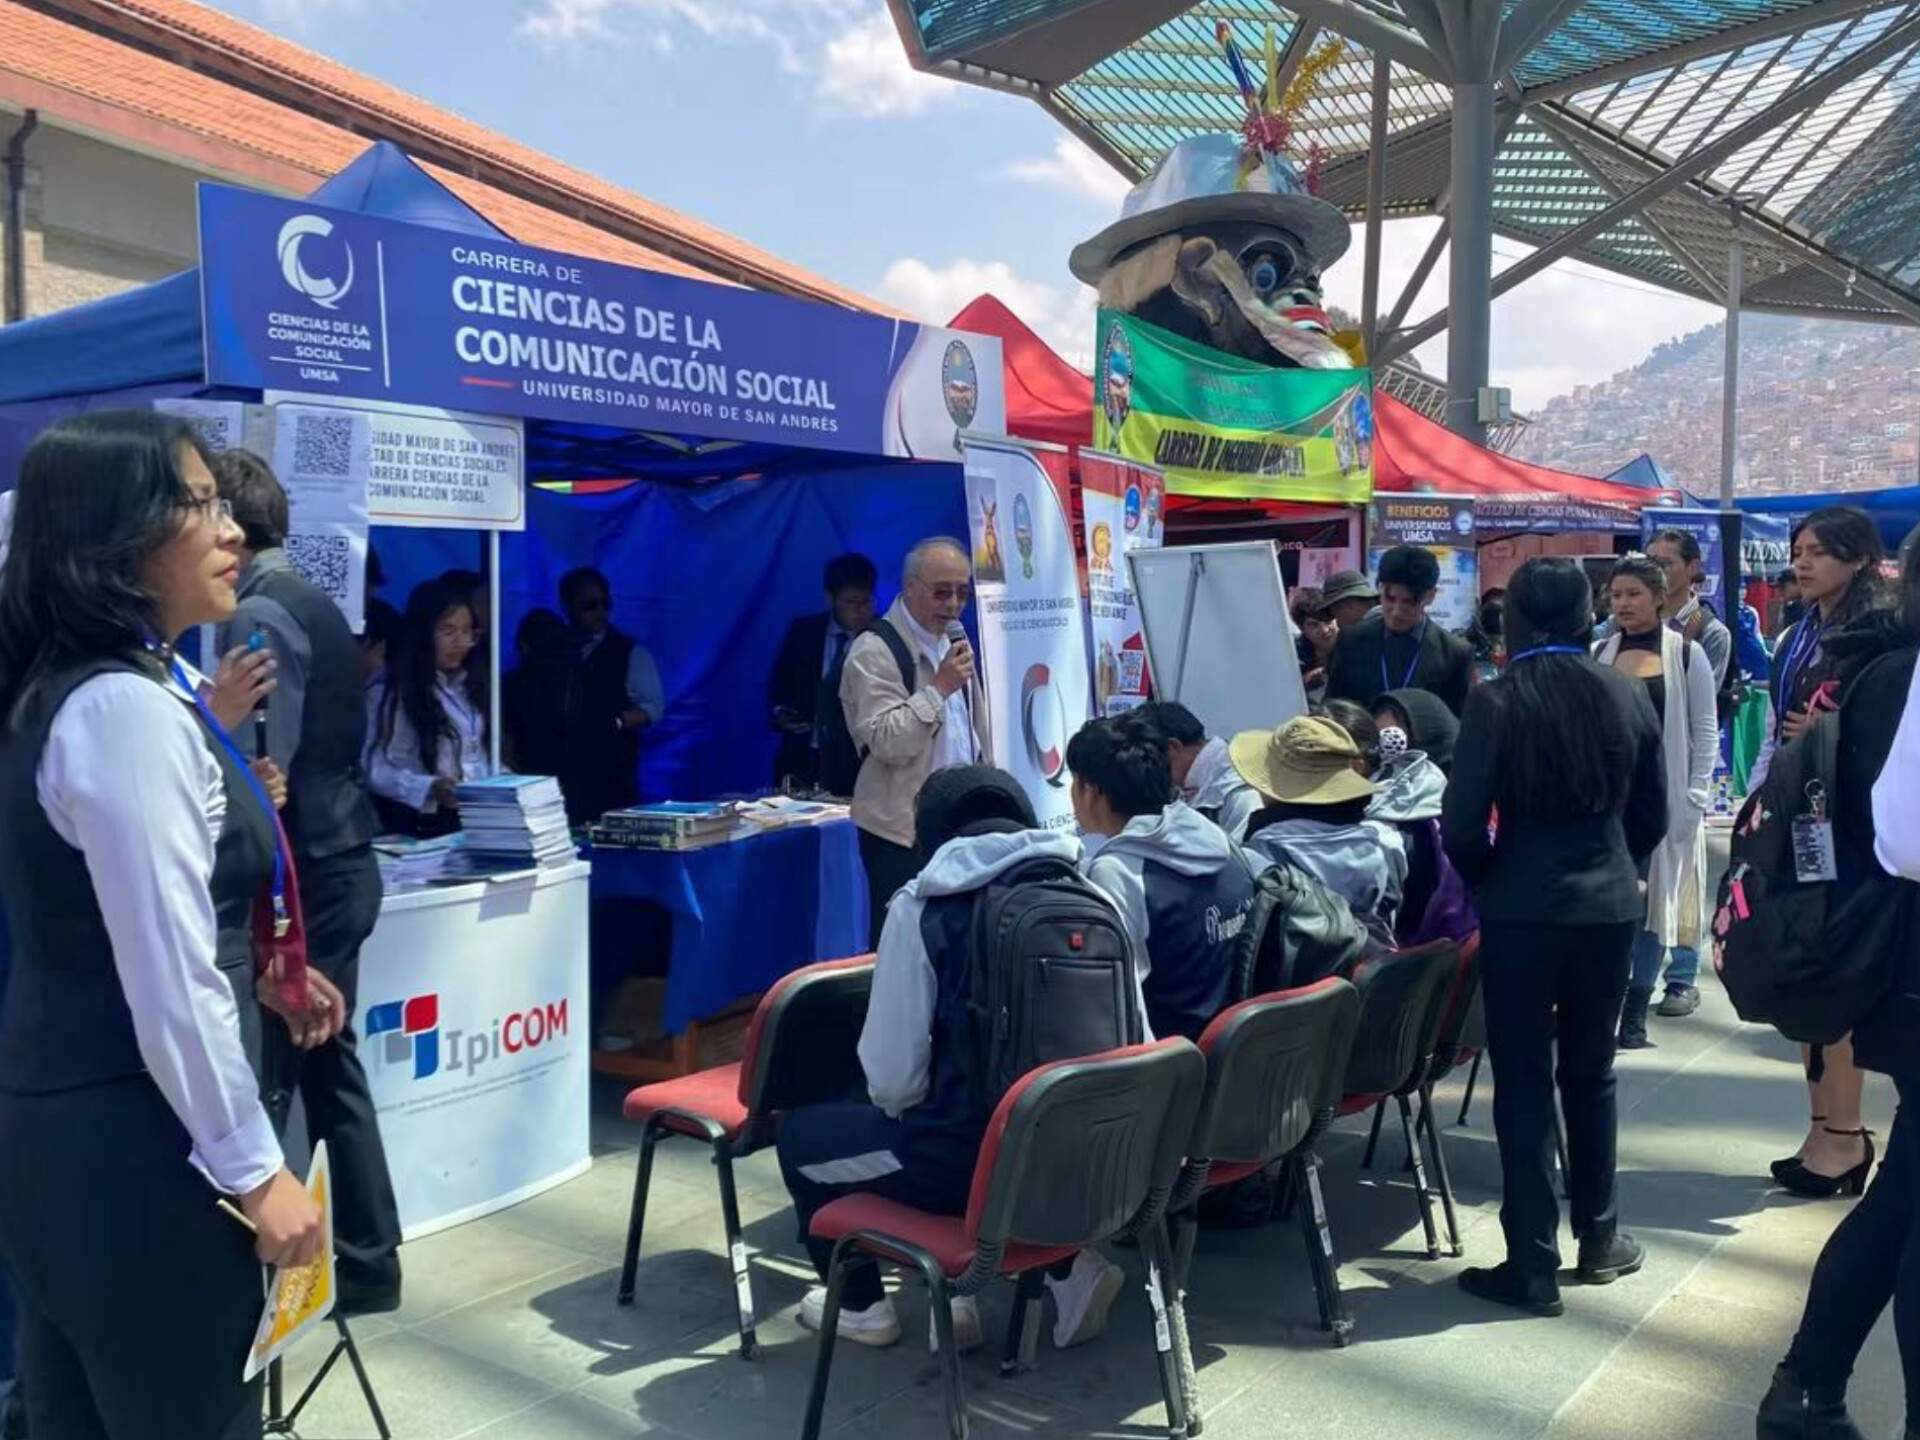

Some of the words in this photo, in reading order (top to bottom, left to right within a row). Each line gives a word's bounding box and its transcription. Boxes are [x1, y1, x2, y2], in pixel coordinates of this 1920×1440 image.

[451, 247, 549, 278] CARRERA
[556, 265, 583, 284] DE
[452, 275, 626, 334] CIENCIAS
[634, 306, 677, 343] DE
[685, 315, 722, 351] LA
[268, 312, 330, 331] CIENCIAS
[332, 321, 350, 334] DE
[352, 325, 369, 337] LA
[267, 327, 371, 351] COMUNICACIÓN
[295, 345, 343, 362] SOCIAL
[300, 367, 339, 382] UMSA
[455, 326, 728, 396] COMUNICACIÓN
[736, 369, 836, 410] SOCIAL
[522, 379, 649, 409] UNIVERSIDAD
[656, 396, 713, 418] MAYOR
[719, 405, 740, 421] DE
[745, 409, 775, 425] SAN
[780, 412, 839, 433] ANDRÉS
[406, 434, 440, 449] MAYOR
[443, 438, 456, 452] DE
[459, 439, 478, 454] SAN
[397, 449, 411, 465] DE
[414, 451, 460, 469] CIENCIAS
[463, 457, 507, 473] SOCIALES
[413, 468, 459, 486] CIENCIAS
[462, 473, 475, 487] DE
[477, 474, 489, 488] LA
[451, 488, 486, 503] SOCIAL
[1387, 505, 1449, 518] BENEFICIOS
[1384, 521, 1451, 531] UNIVERSITARIOS
[1402, 531, 1435, 543] UMSA
[446, 998, 568, 1078] IpiCOM
